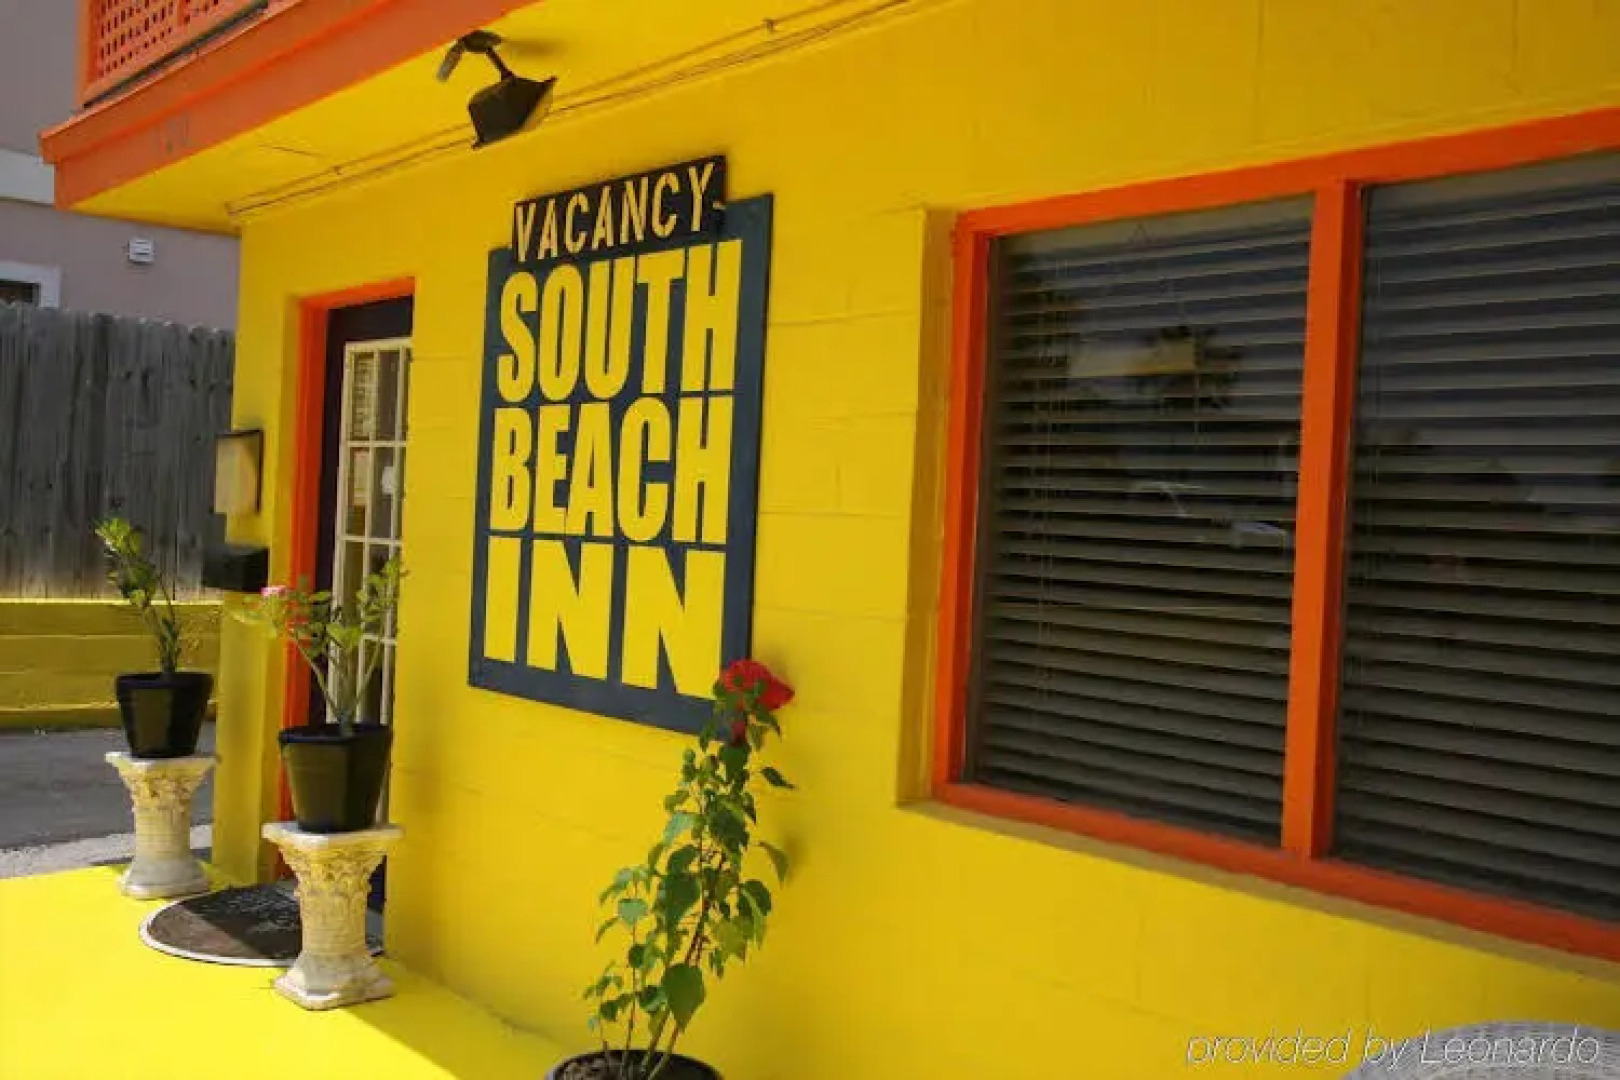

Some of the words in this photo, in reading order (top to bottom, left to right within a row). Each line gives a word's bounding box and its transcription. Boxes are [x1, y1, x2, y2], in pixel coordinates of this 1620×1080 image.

[515, 162, 715, 263] VACANCY
[496, 239, 743, 403] SOUTH
[489, 396, 734, 541] BEACH
[483, 535, 727, 700] INN
